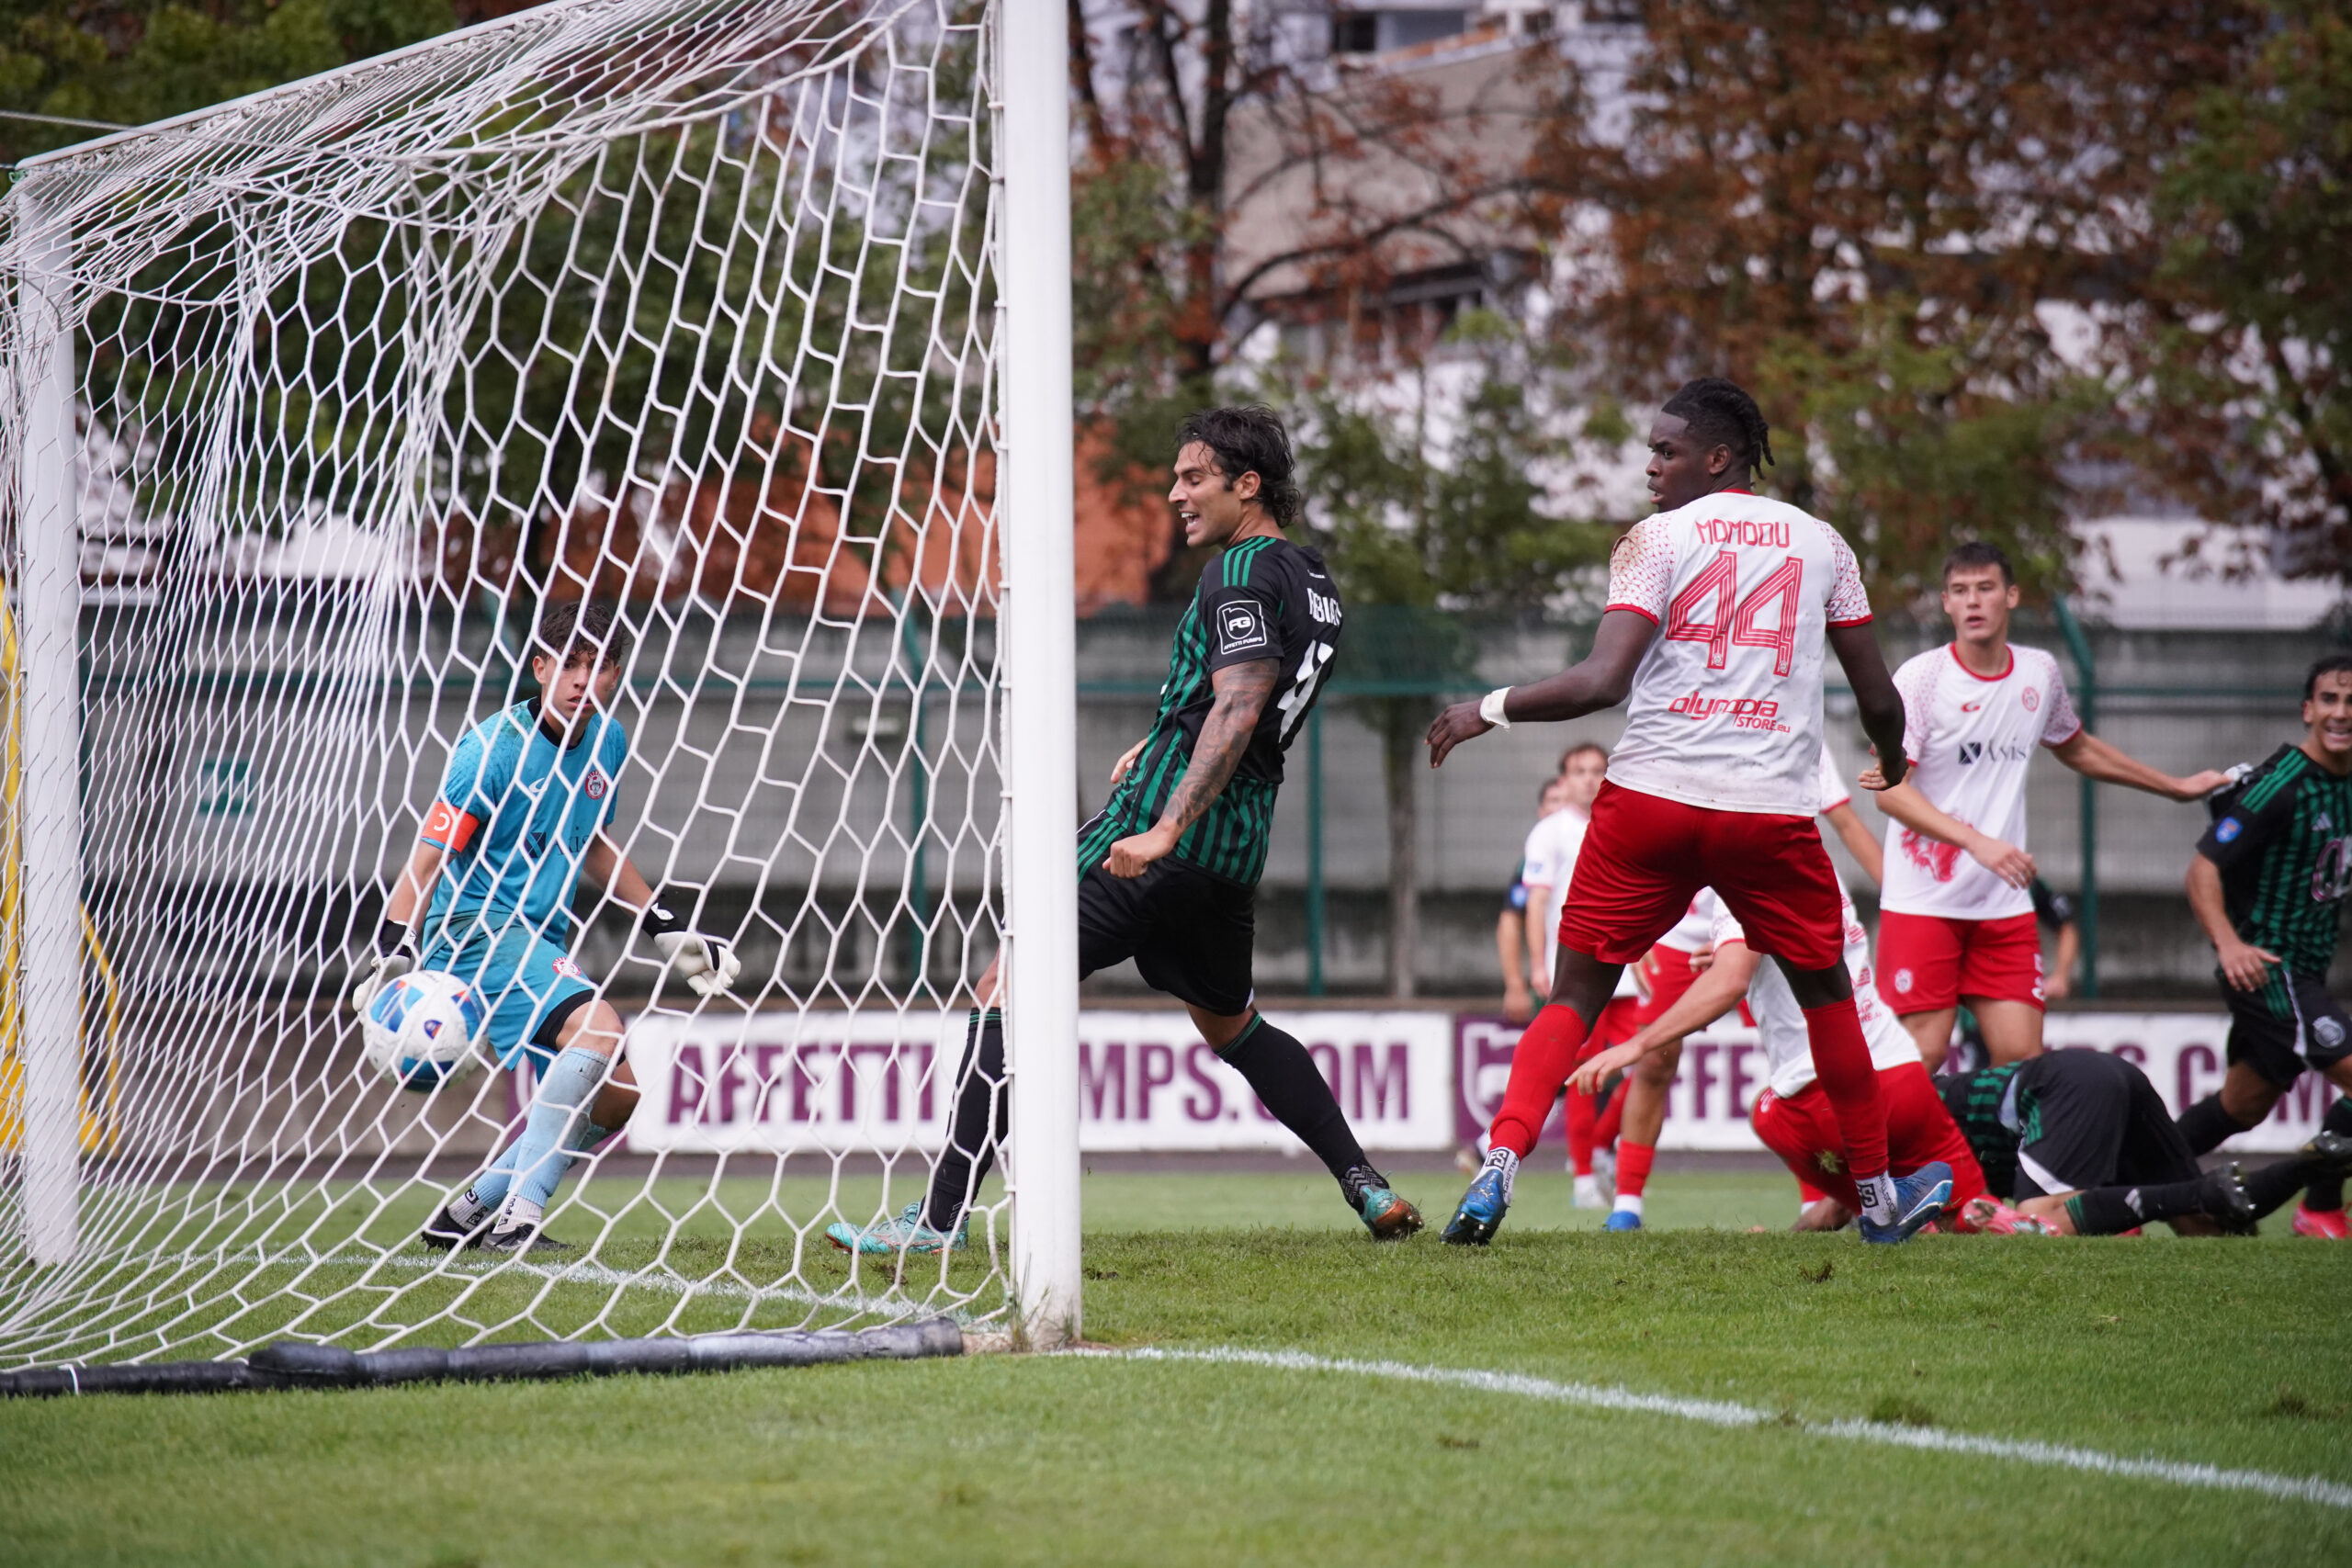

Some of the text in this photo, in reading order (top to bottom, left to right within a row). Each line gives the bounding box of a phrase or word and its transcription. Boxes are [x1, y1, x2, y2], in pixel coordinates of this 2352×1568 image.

[1695, 518, 1791, 548] MOMODU
[1665, 550, 1804, 678] 44
[668, 1043, 933, 1123] AFFETTI
[1487, 1150, 1507, 1168] FS
[1857, 1185, 1875, 1208] S
